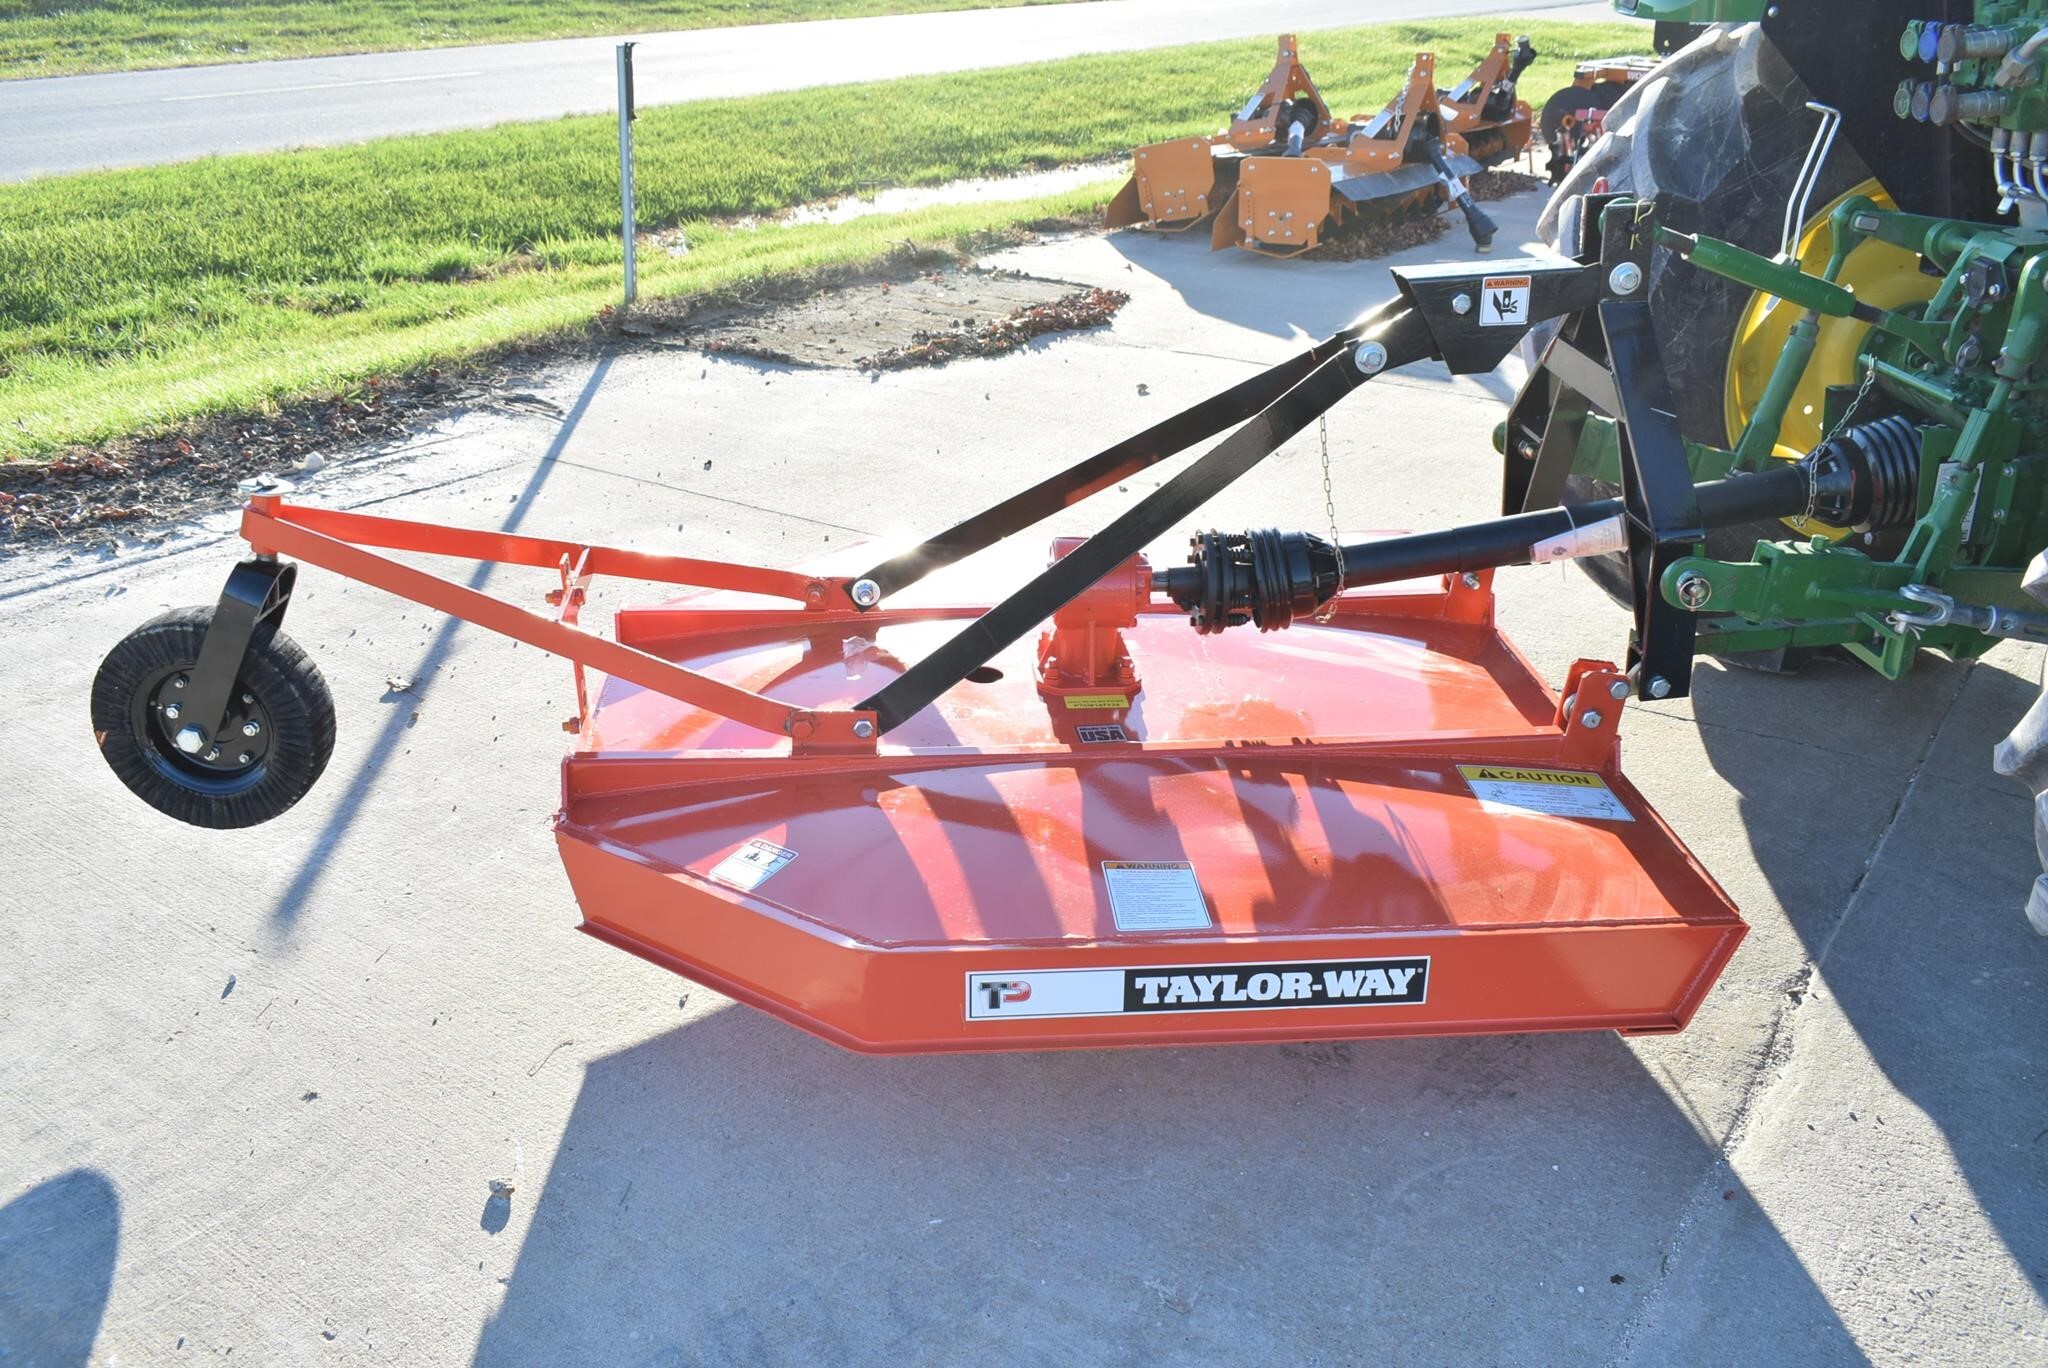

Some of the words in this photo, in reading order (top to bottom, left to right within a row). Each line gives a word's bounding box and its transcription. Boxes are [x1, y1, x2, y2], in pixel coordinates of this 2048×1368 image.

[1494, 278, 1528, 287] WARNING
[1080, 730, 1125, 742] USA
[1499, 770, 1591, 785] CAUTION
[1135, 967, 1416, 1004] TAYLOR-WAY
